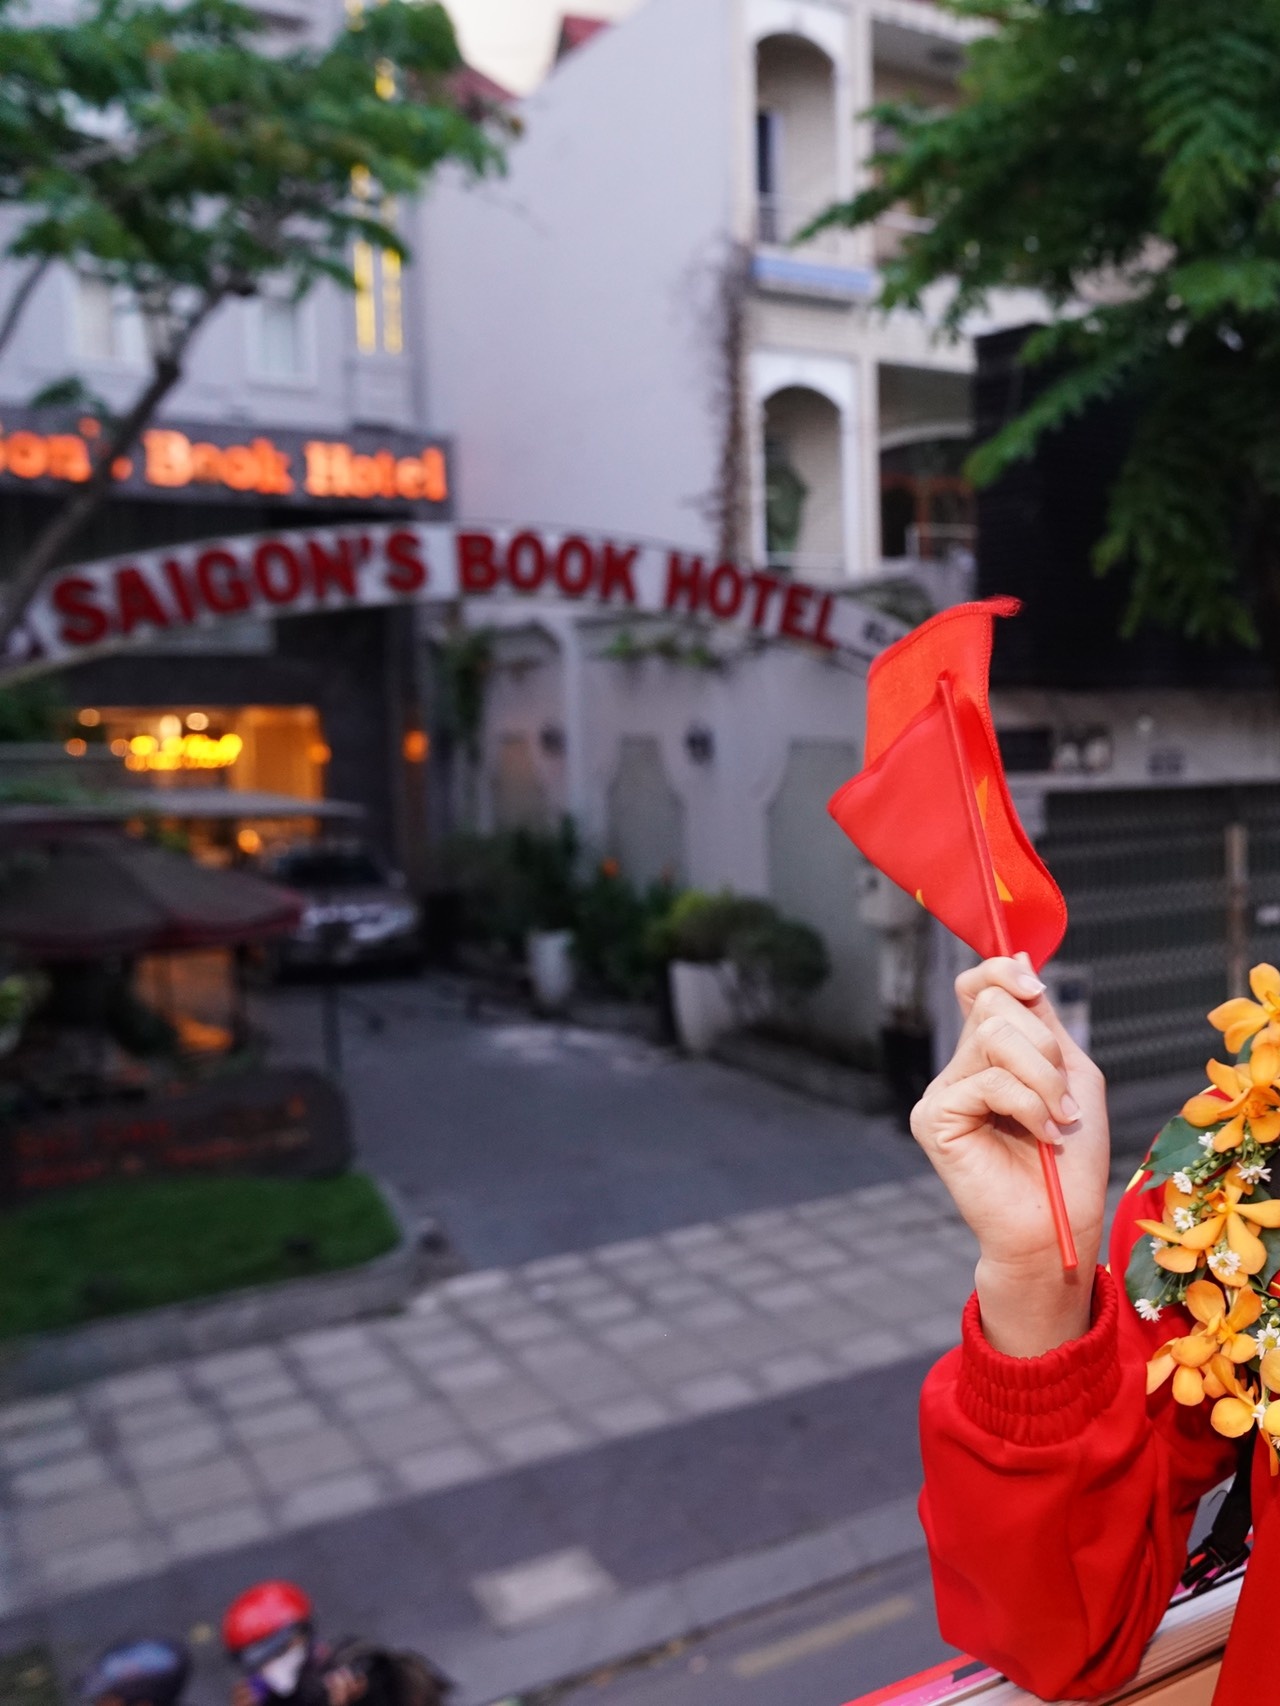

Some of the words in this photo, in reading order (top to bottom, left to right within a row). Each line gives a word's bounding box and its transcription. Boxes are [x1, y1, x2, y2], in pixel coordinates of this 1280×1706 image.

[144, 429, 293, 495] Book
[304, 440, 448, 501] Hotel
[53, 529, 427, 645] SAIGON'S
[456, 530, 639, 604] BOOK
[664, 550, 841, 651] HOTEL
